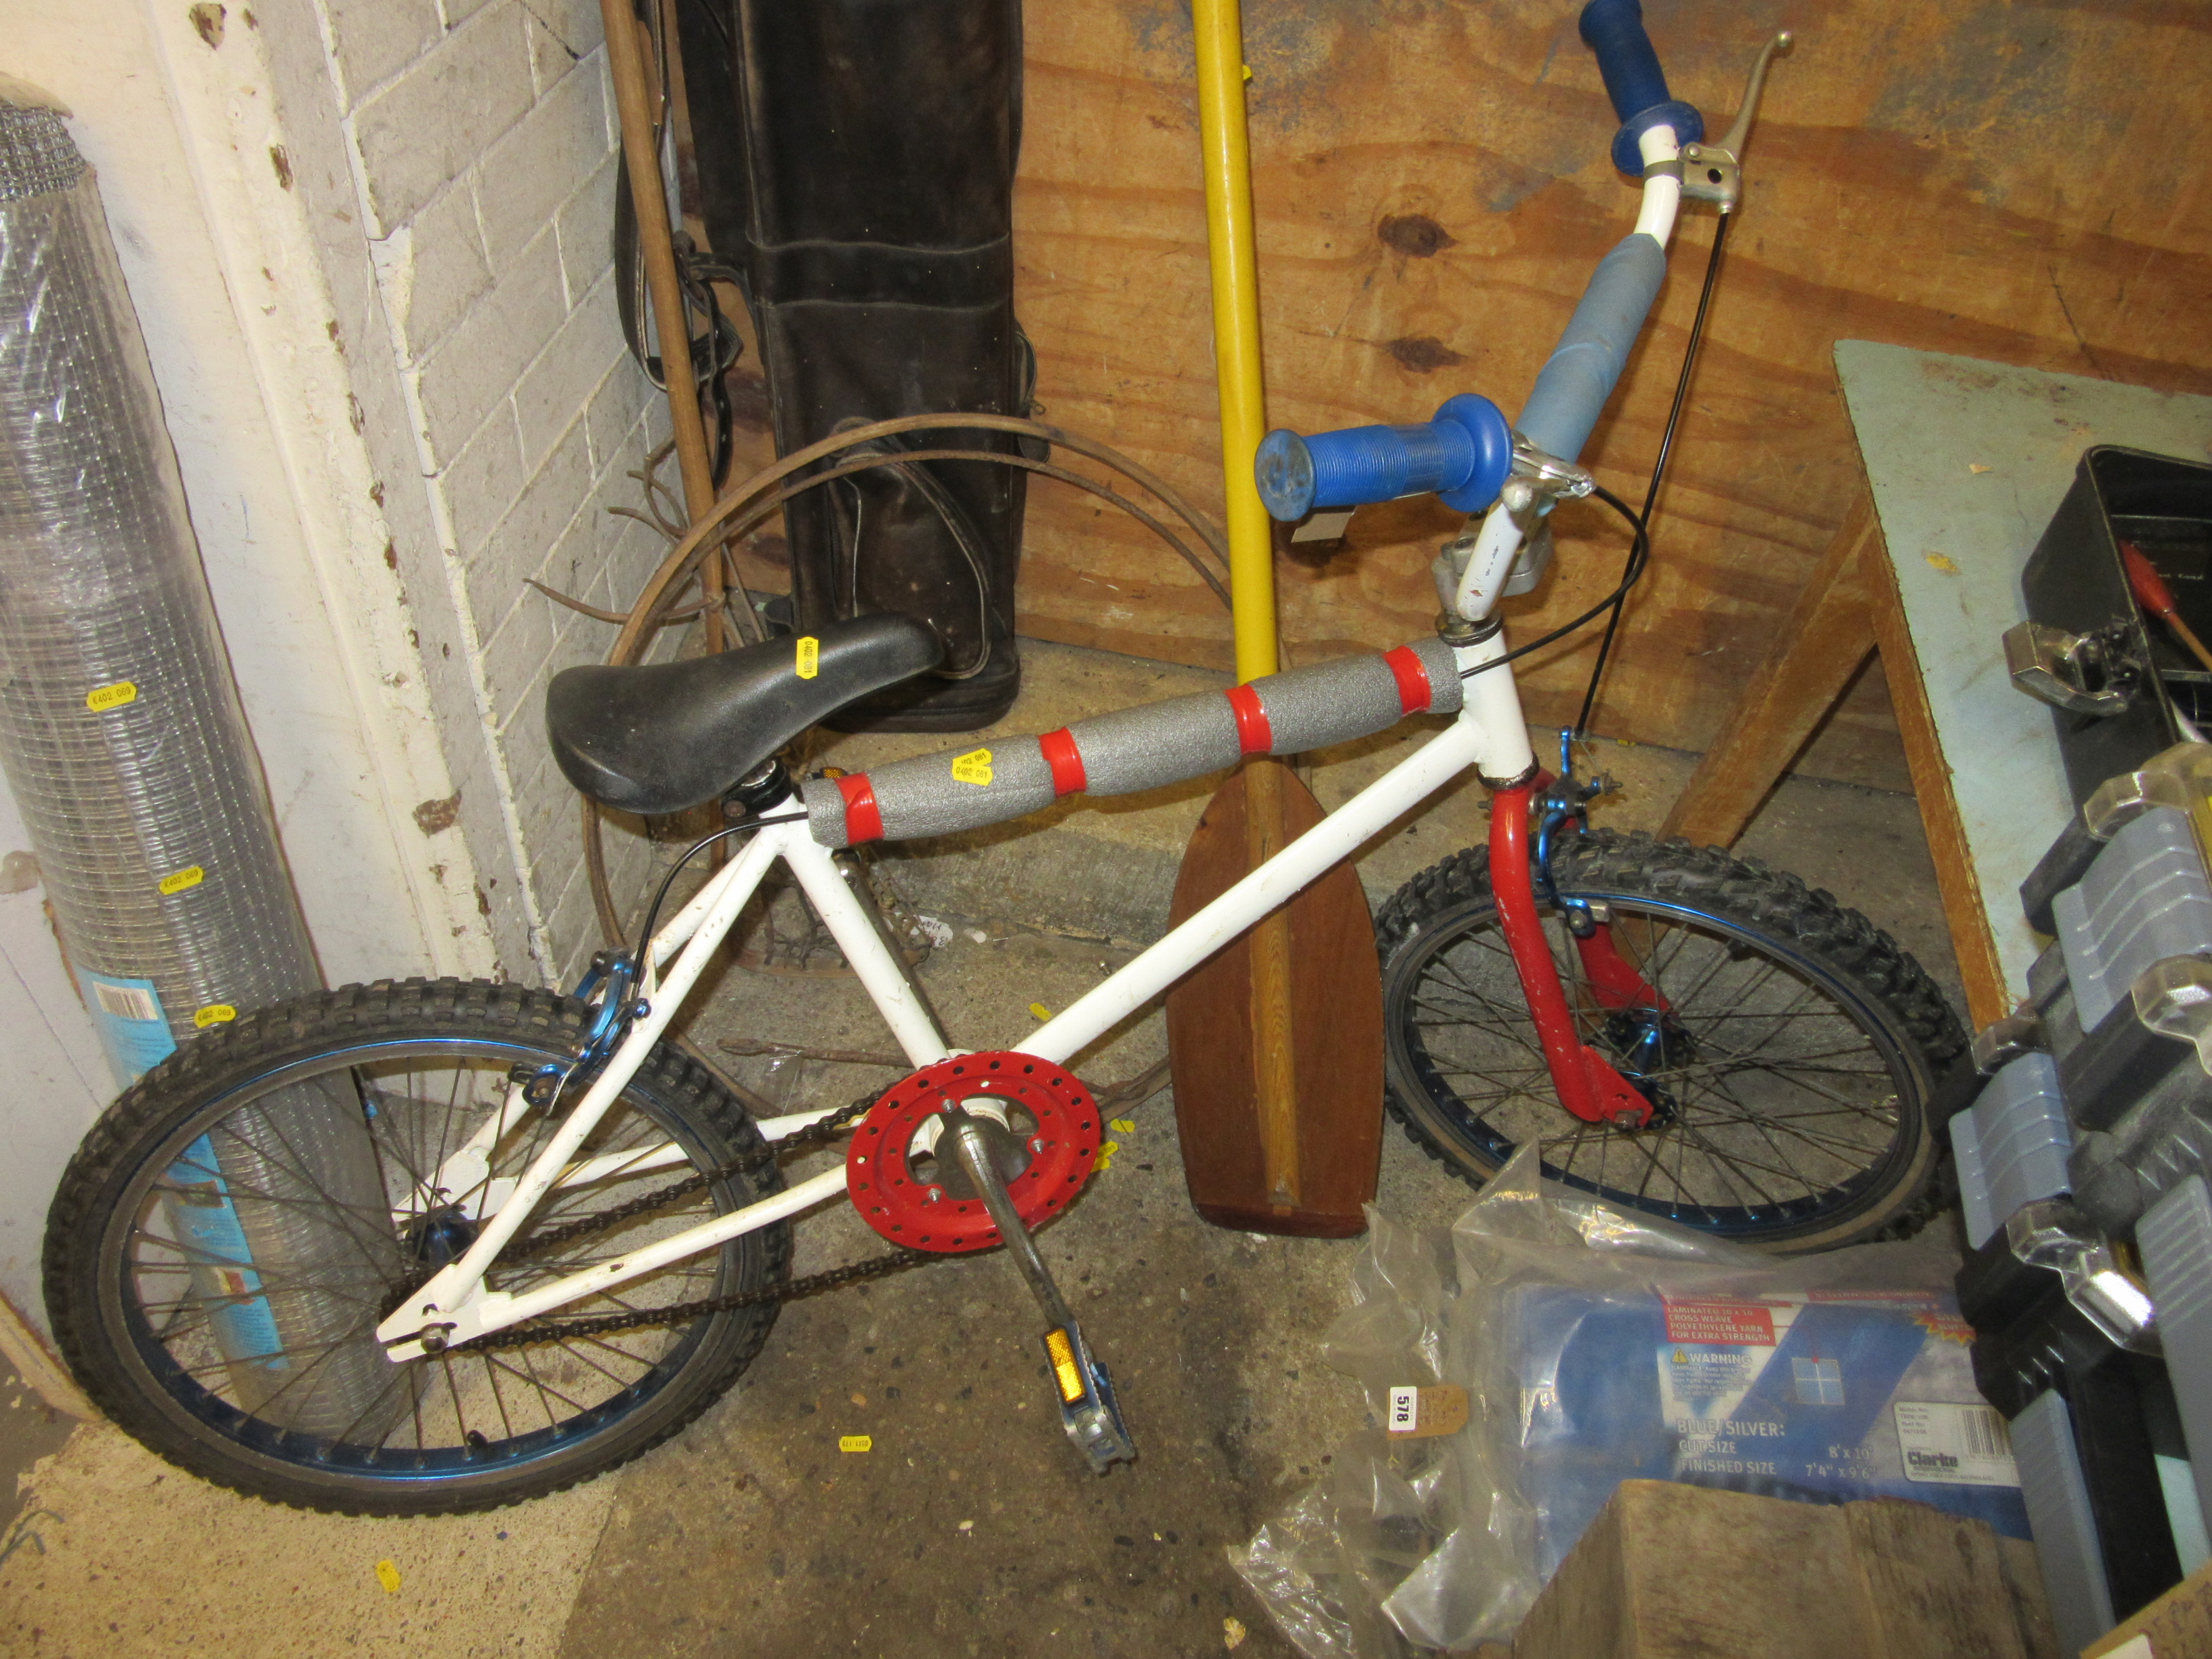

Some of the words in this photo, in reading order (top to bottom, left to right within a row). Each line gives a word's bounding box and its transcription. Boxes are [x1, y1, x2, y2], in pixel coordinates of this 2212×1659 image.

[974, 752, 987, 761] 081
[975, 770, 987, 778] 081
[1668, 1306, 1719, 1315] LAMINATED
[1701, 1315, 1732, 1324] WEAVE
[1670, 1322, 1738, 1332] POLYETHYLENE
[1740, 1324, 1763, 1332] YARN
[1671, 1331, 1690, 1339] FOR
[1692, 1332, 1720, 1340] EXTRA
[1721, 1332, 1770, 1342] STRENGTH
[1397, 1395, 1410, 1422] 578
[1677, 1418, 1786, 1437] BLUE/SILVER:
[1679, 1439, 1705, 1453] CUT
[1708, 1441, 1737, 1454] SIZE
[1907, 1451, 1959, 1467] Clarke
[1681, 1459, 1743, 1474] FINISHED
[1746, 1462, 1777, 1475] SIZE
